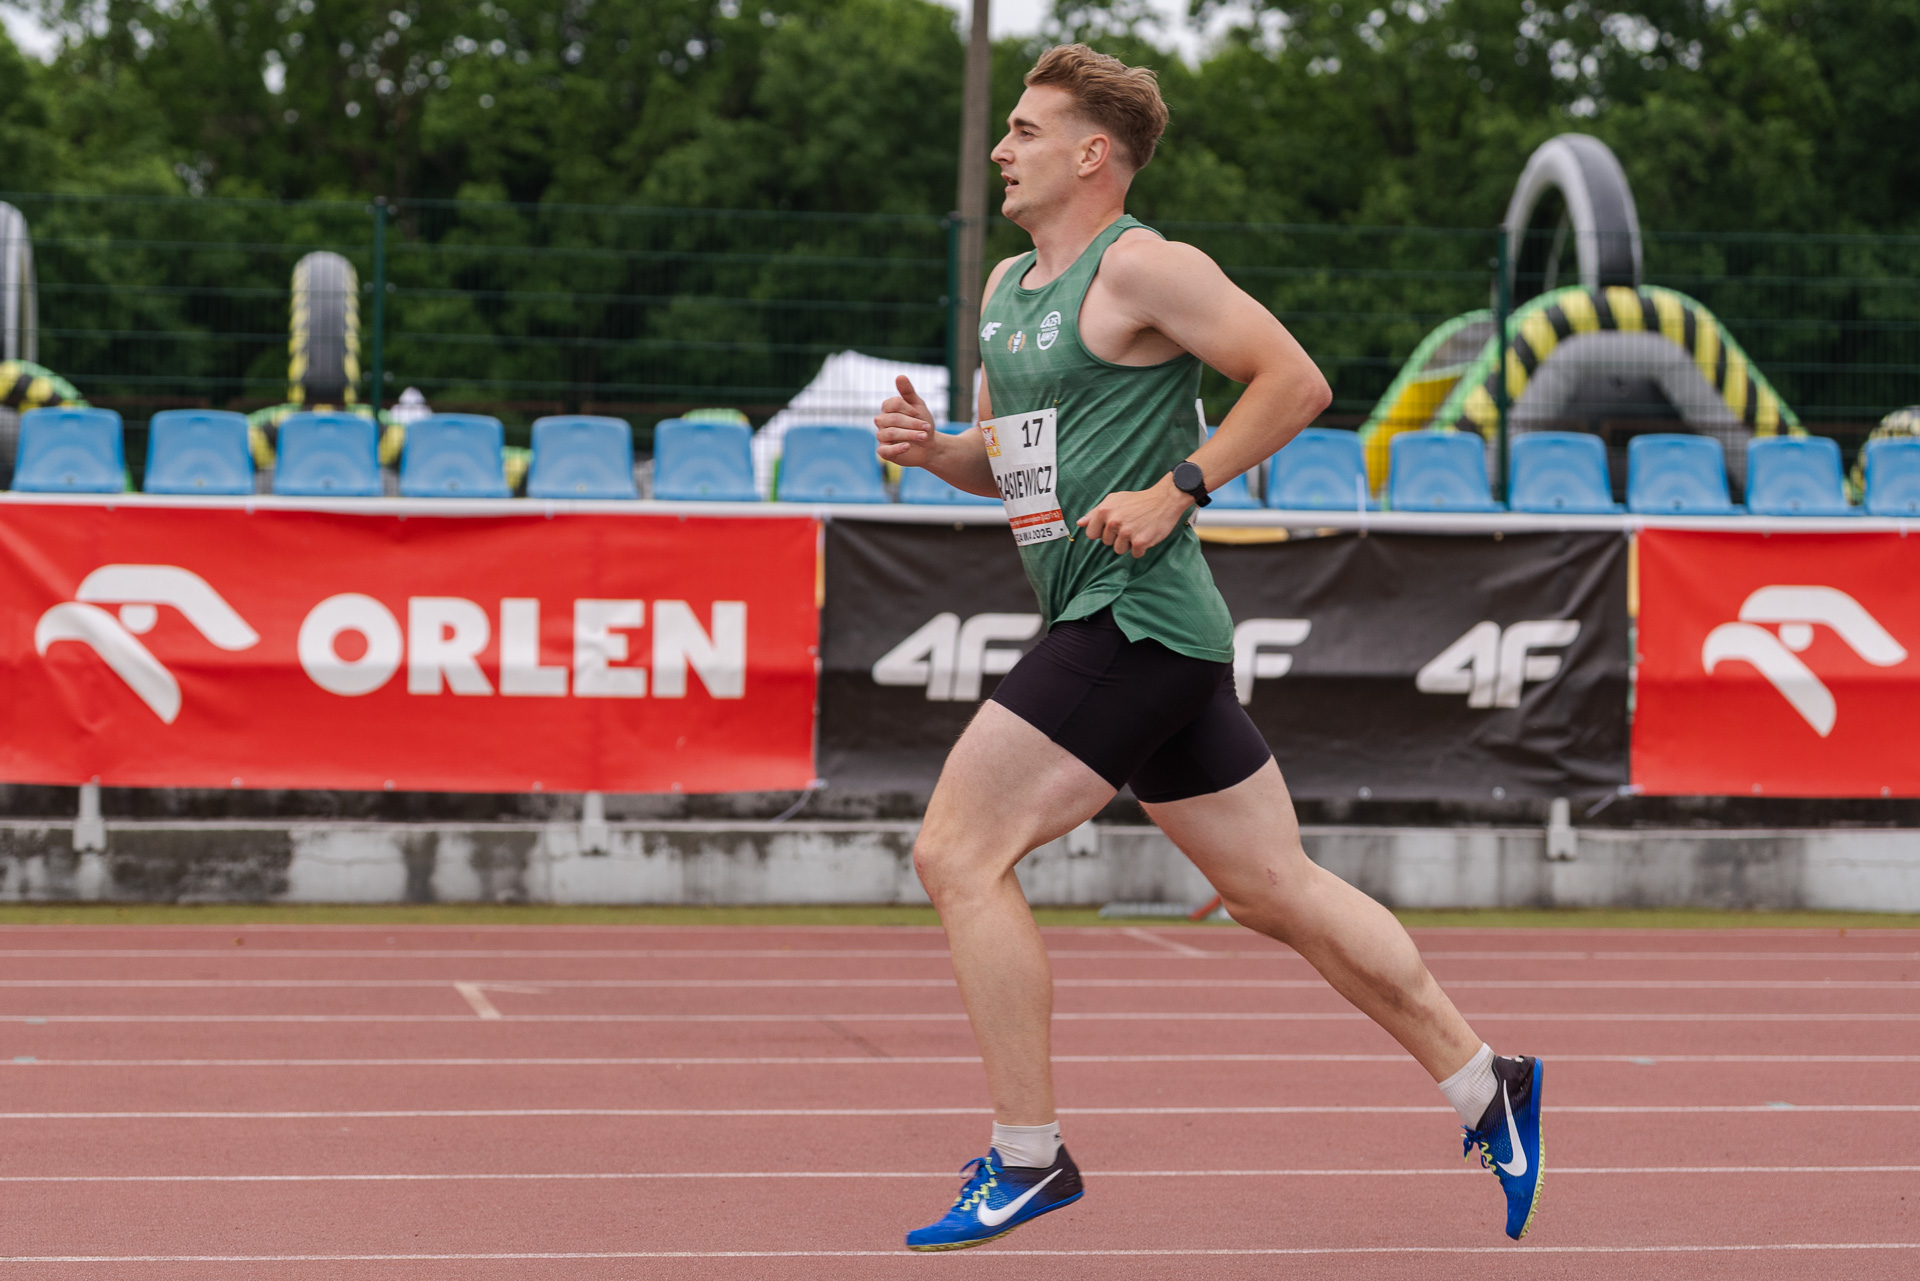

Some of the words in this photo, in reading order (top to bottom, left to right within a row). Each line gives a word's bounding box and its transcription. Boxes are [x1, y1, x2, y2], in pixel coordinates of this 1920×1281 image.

[981, 322, 1002, 341] 4F
[1021, 418, 1043, 448] 17
[297, 592, 748, 699] ORLEN
[873, 612, 1043, 701] 4F
[1232, 617, 1313, 706] F
[1415, 618, 1582, 709] 4F
